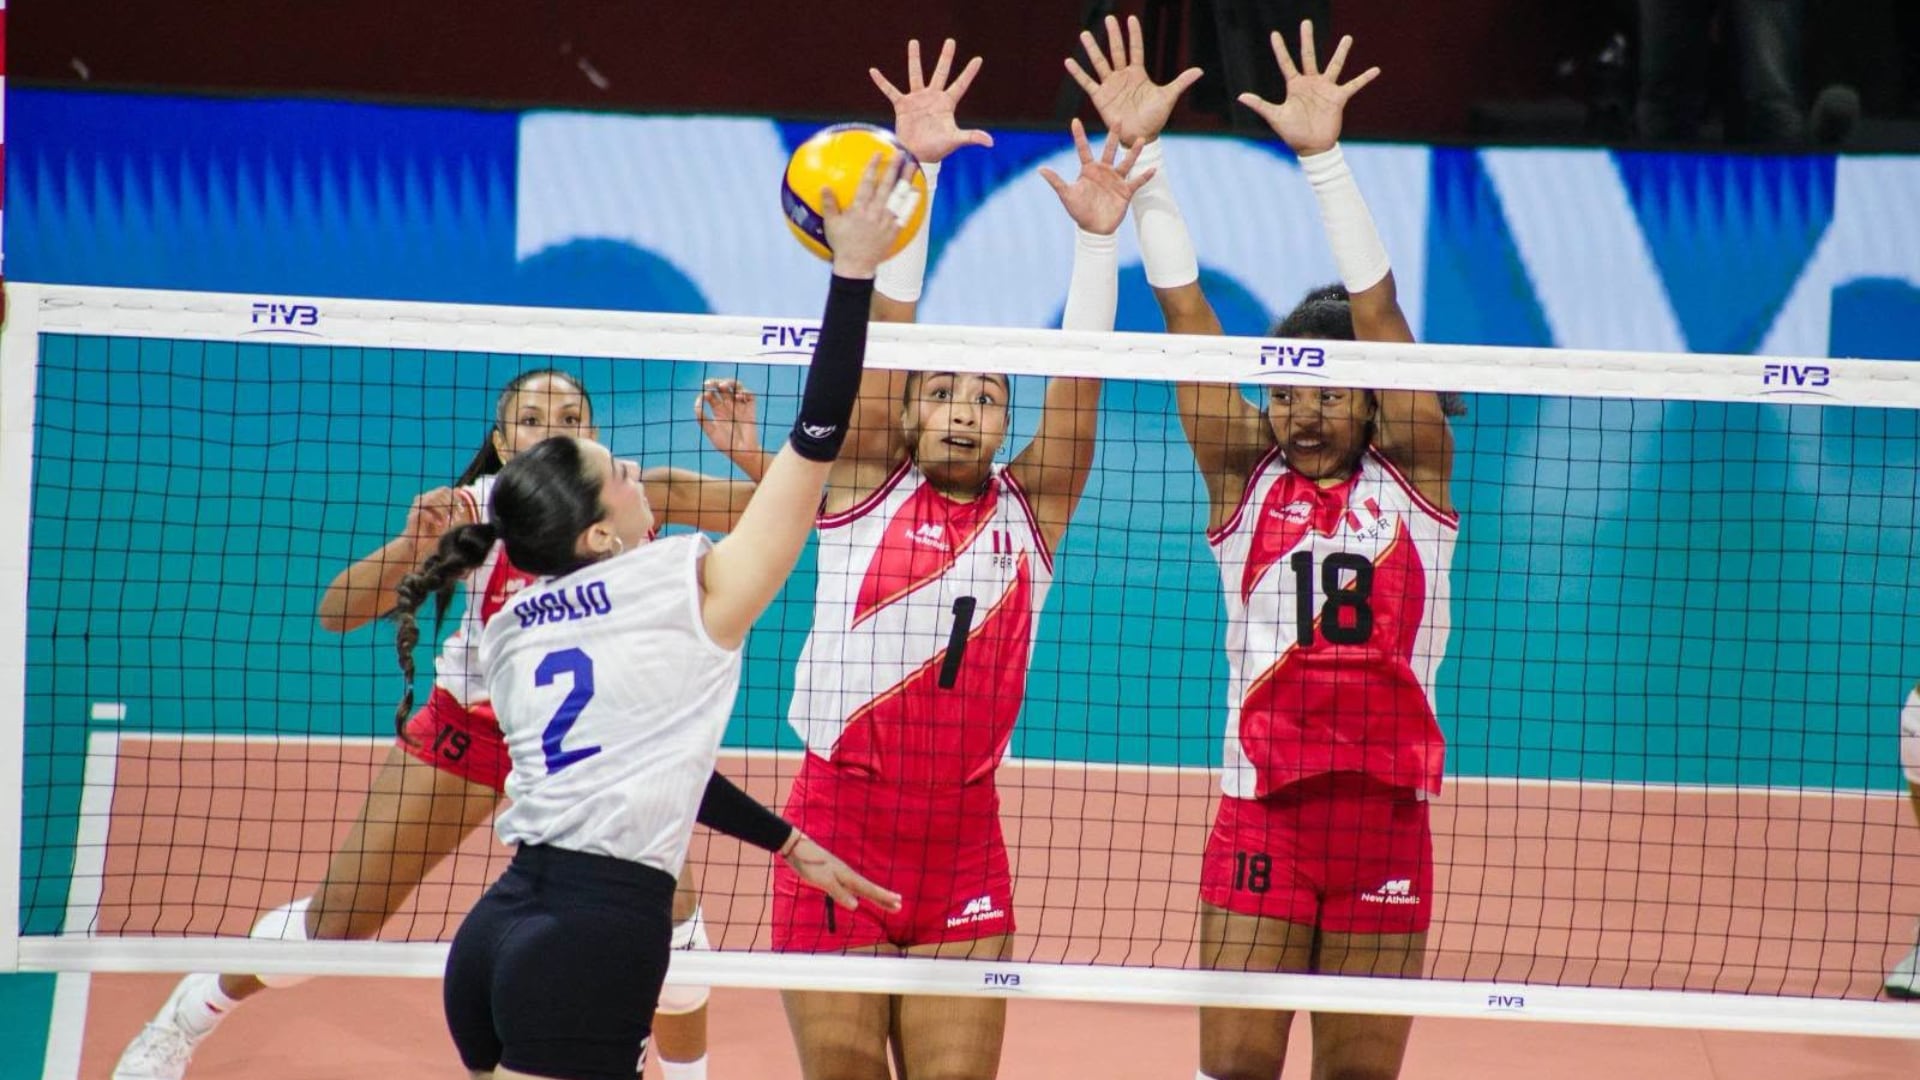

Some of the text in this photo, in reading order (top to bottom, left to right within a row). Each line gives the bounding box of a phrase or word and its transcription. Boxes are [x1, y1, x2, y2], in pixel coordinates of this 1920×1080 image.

[252, 303, 319, 326] FIVB
[1260, 346, 1325, 368] FIVB
[1763, 364, 1830, 387] FIVB
[1290, 550, 1375, 648] 18
[937, 595, 977, 690] 1
[534, 646, 602, 776] 2
[432, 723, 472, 762] 19
[1234, 851, 1273, 894] 18
[1361, 892, 1385, 904] New
[946, 916, 970, 929] New
[984, 972, 1021, 986] FIVB
[1487, 995, 1525, 1008] FIVB
